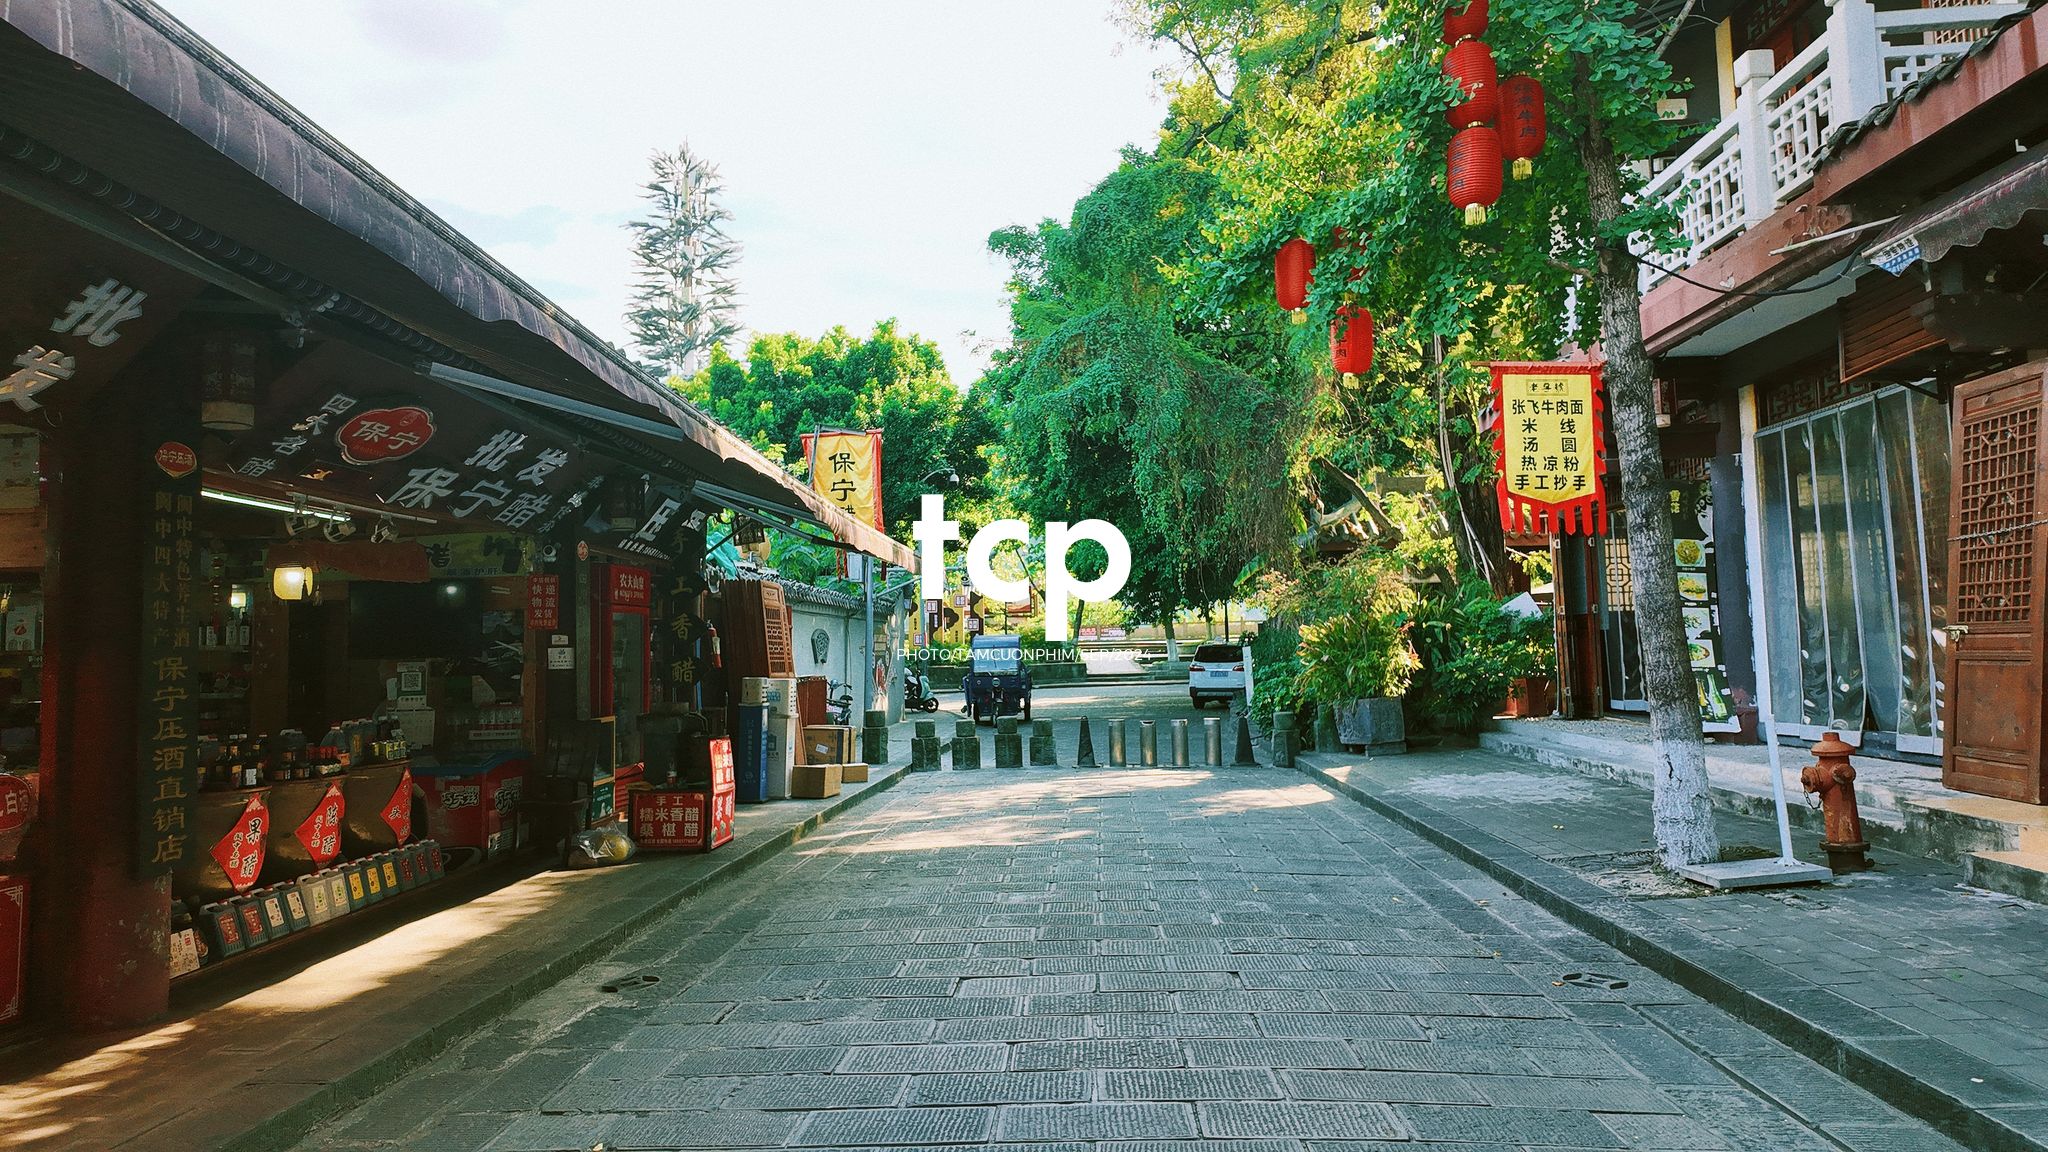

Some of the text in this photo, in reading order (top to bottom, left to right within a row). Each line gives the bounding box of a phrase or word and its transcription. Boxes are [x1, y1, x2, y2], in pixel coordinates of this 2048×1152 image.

[1512, 399, 1584, 415] 张飞牛肉面
[1521, 418, 1577, 434] 米线
[352, 420, 421, 450] 保宁
[1522, 437, 1578, 453] 汤圆
[464, 428, 569, 487] 批发
[1521, 455, 1580, 471] 热凉粉
[1514, 474, 1587, 491] 手工抄手
[384, 467, 553, 530] 保宁醋
[671, 528, 697, 683] 手工香醋
[152, 656, 191, 864] 保宁压酒直销店
[655, 795, 684, 806] 手工
[639, 807, 700, 822] 糯米香醋
[240, 817, 262, 878] 果醋
